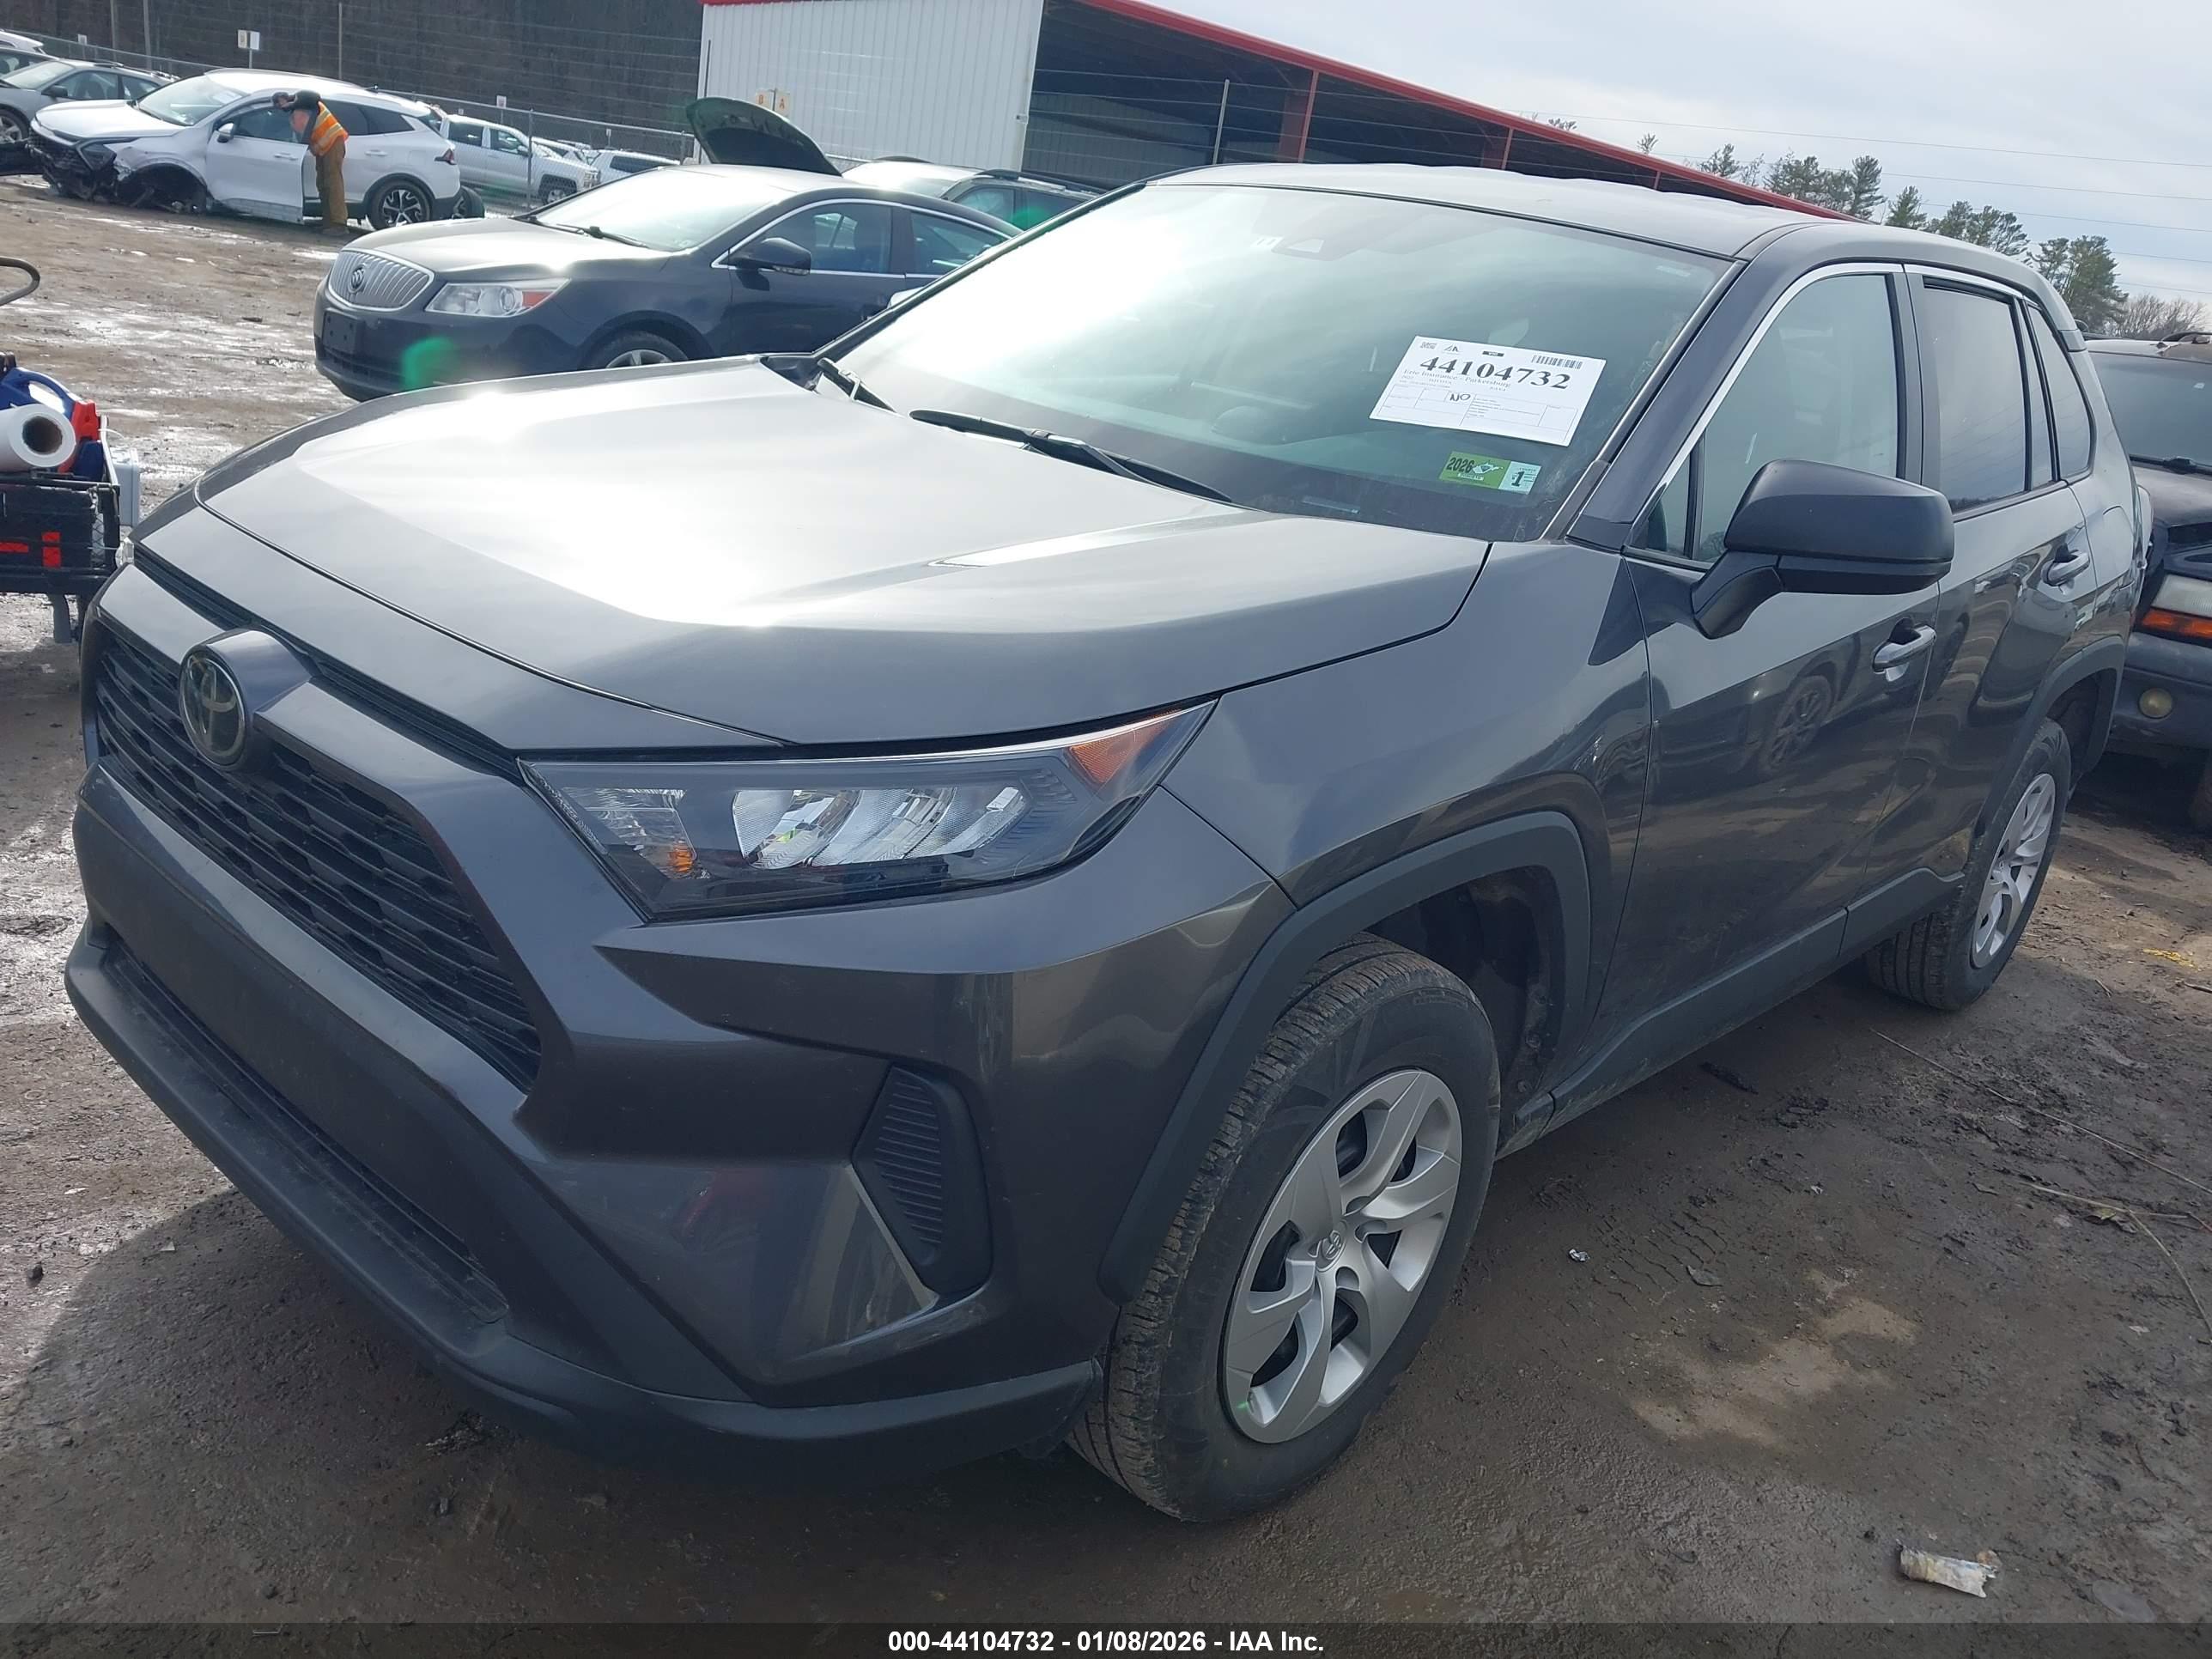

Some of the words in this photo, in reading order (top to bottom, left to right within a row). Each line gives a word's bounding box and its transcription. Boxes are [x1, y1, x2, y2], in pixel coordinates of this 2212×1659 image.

[1419, 357, 1571, 389] 44104732
[1447, 458, 1474, 473] 2026
[1512, 471, 1525, 486] 1
